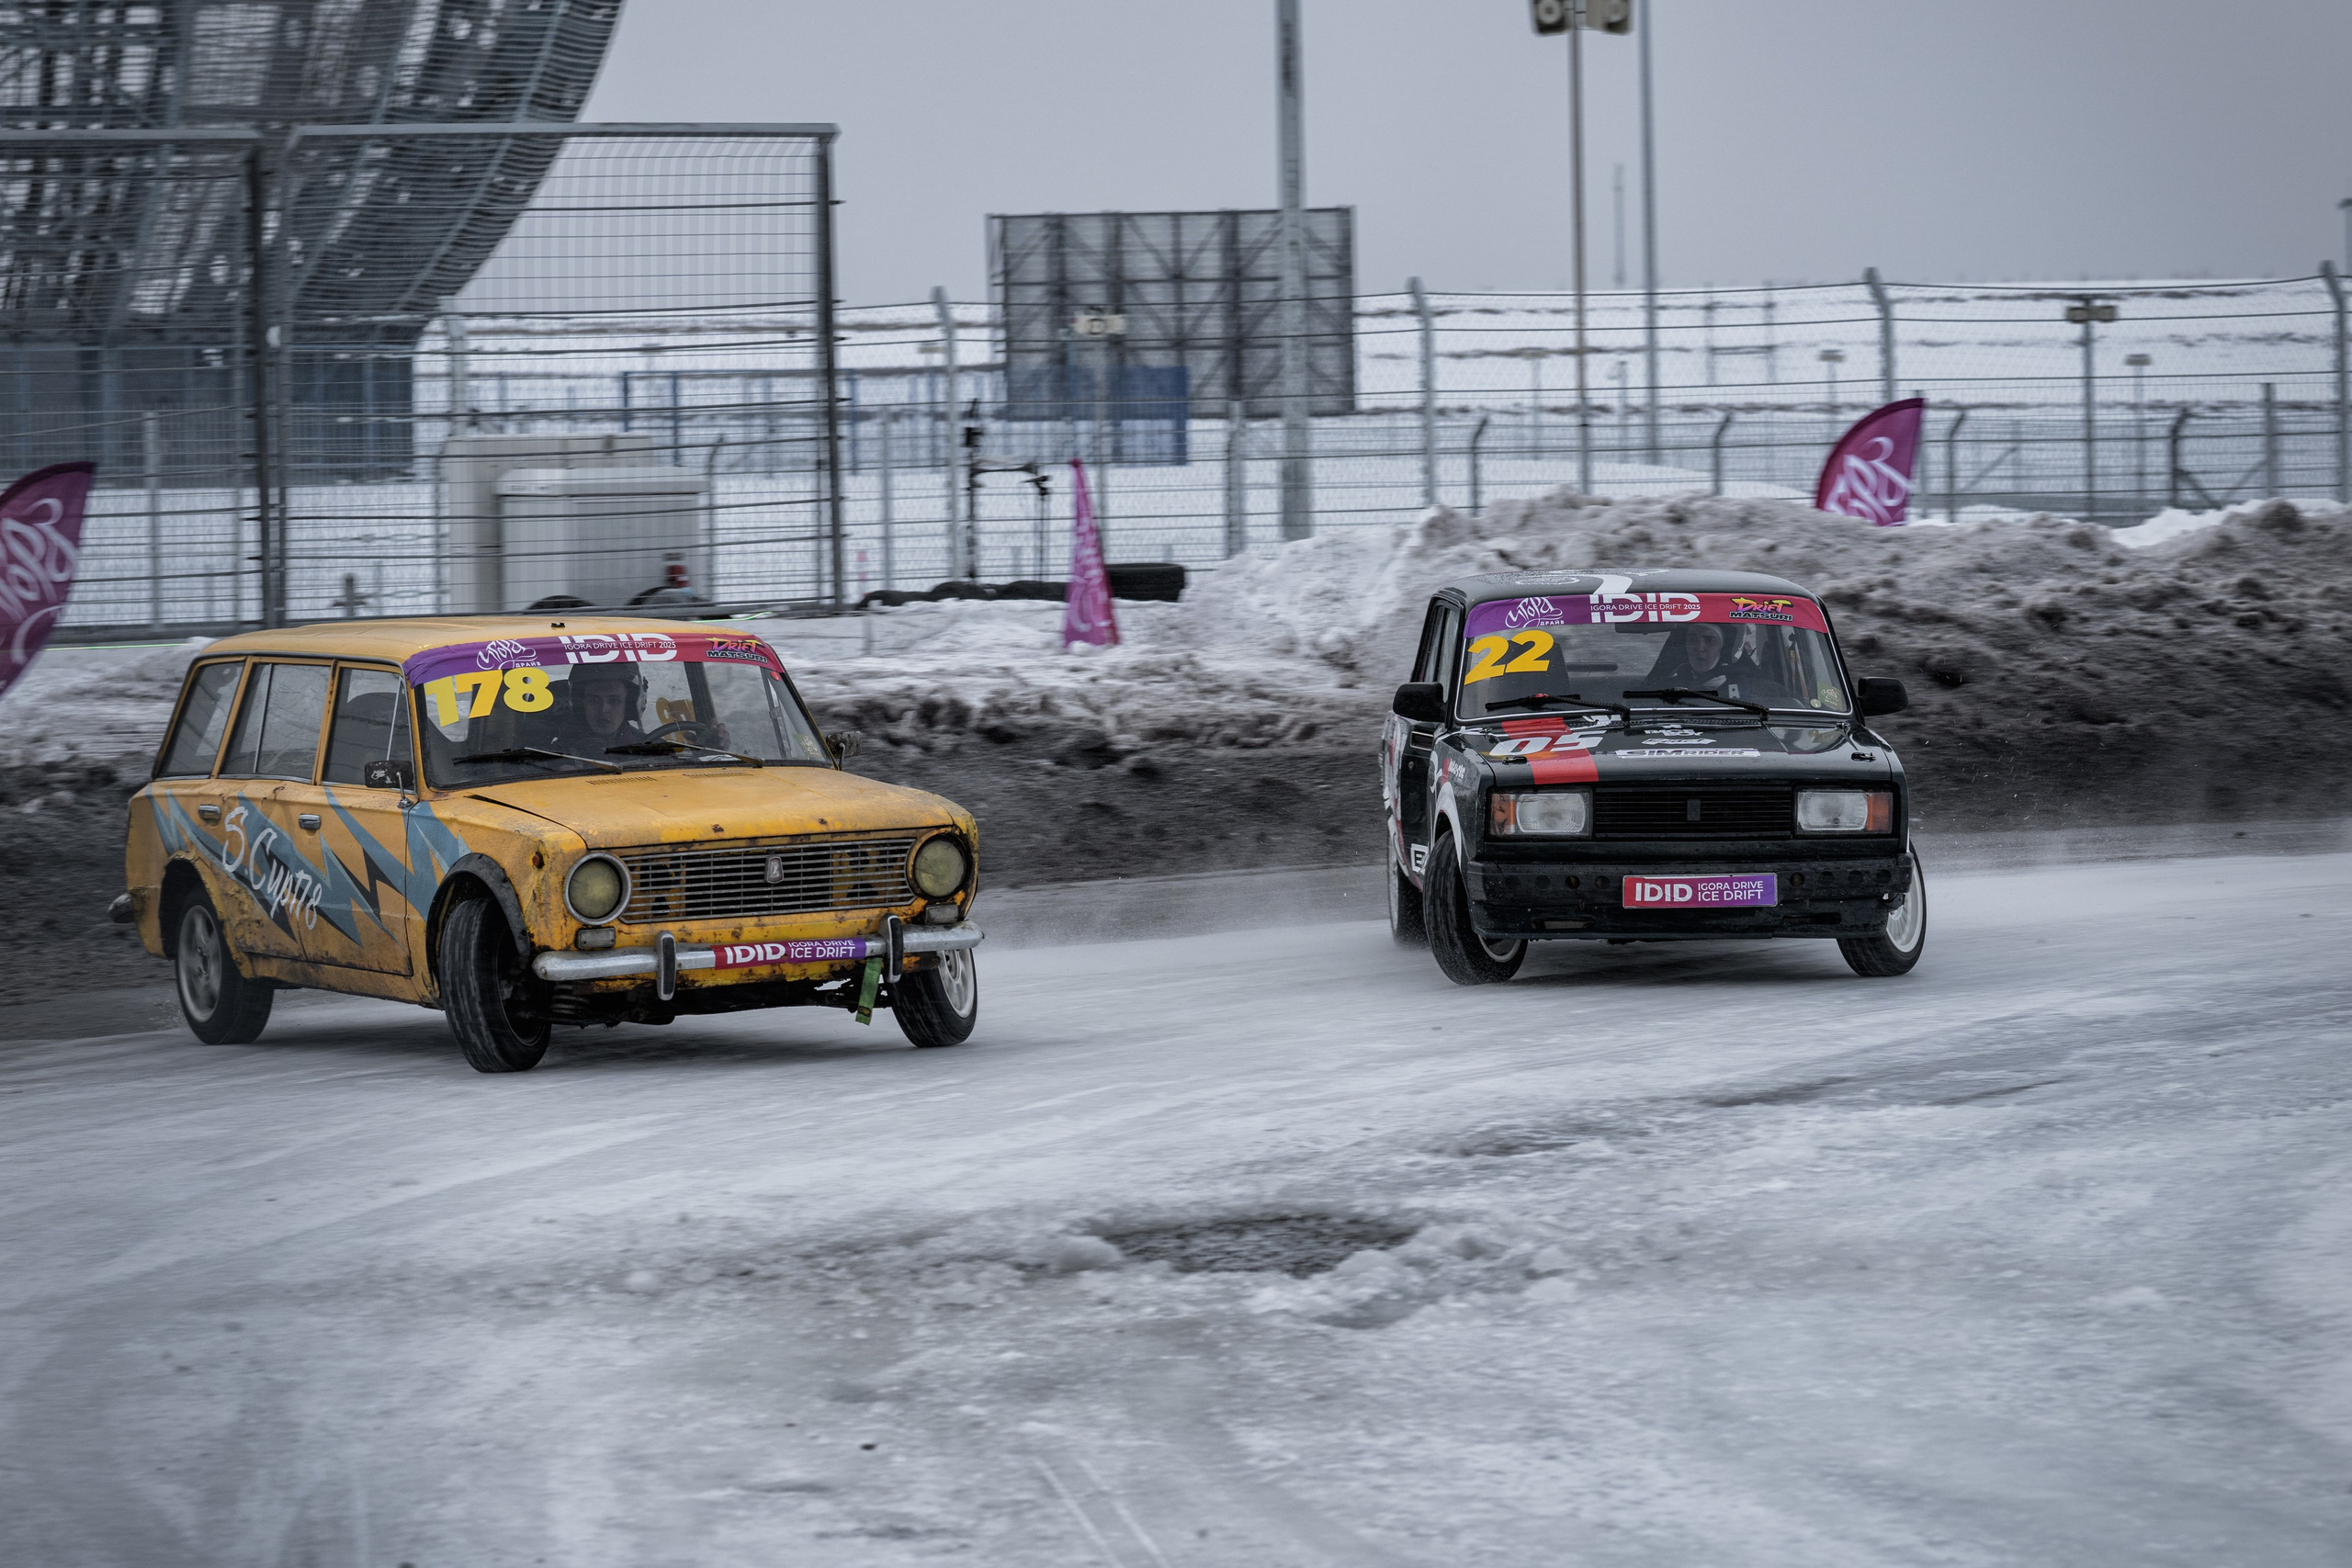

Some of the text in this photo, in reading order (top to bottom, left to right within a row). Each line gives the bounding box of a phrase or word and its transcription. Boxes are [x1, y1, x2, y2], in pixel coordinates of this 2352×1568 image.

[1589, 592, 1701, 624] IDID
[1729, 611, 1792, 622] MATSURI
[558, 632, 678, 664] IDID
[563, 642, 593, 651] IGORA
[594, 641, 618, 650] DRIVE
[659, 641, 676, 649] 2025
[514, 660, 541, 669] ДРАЙВ
[706, 649, 768, 663] MATSURI
[1464, 629, 1555, 686] 22
[424, 667, 554, 728] 178
[1489, 730, 1607, 756] 05
[1635, 882, 1693, 902] IDID
[1698, 880, 1764, 891] IGORA DRIVE
[1698, 889, 1764, 901] ICE DRIFT
[724, 942, 786, 964] IDID
[790, 946, 856, 959] ICE DRIFT
